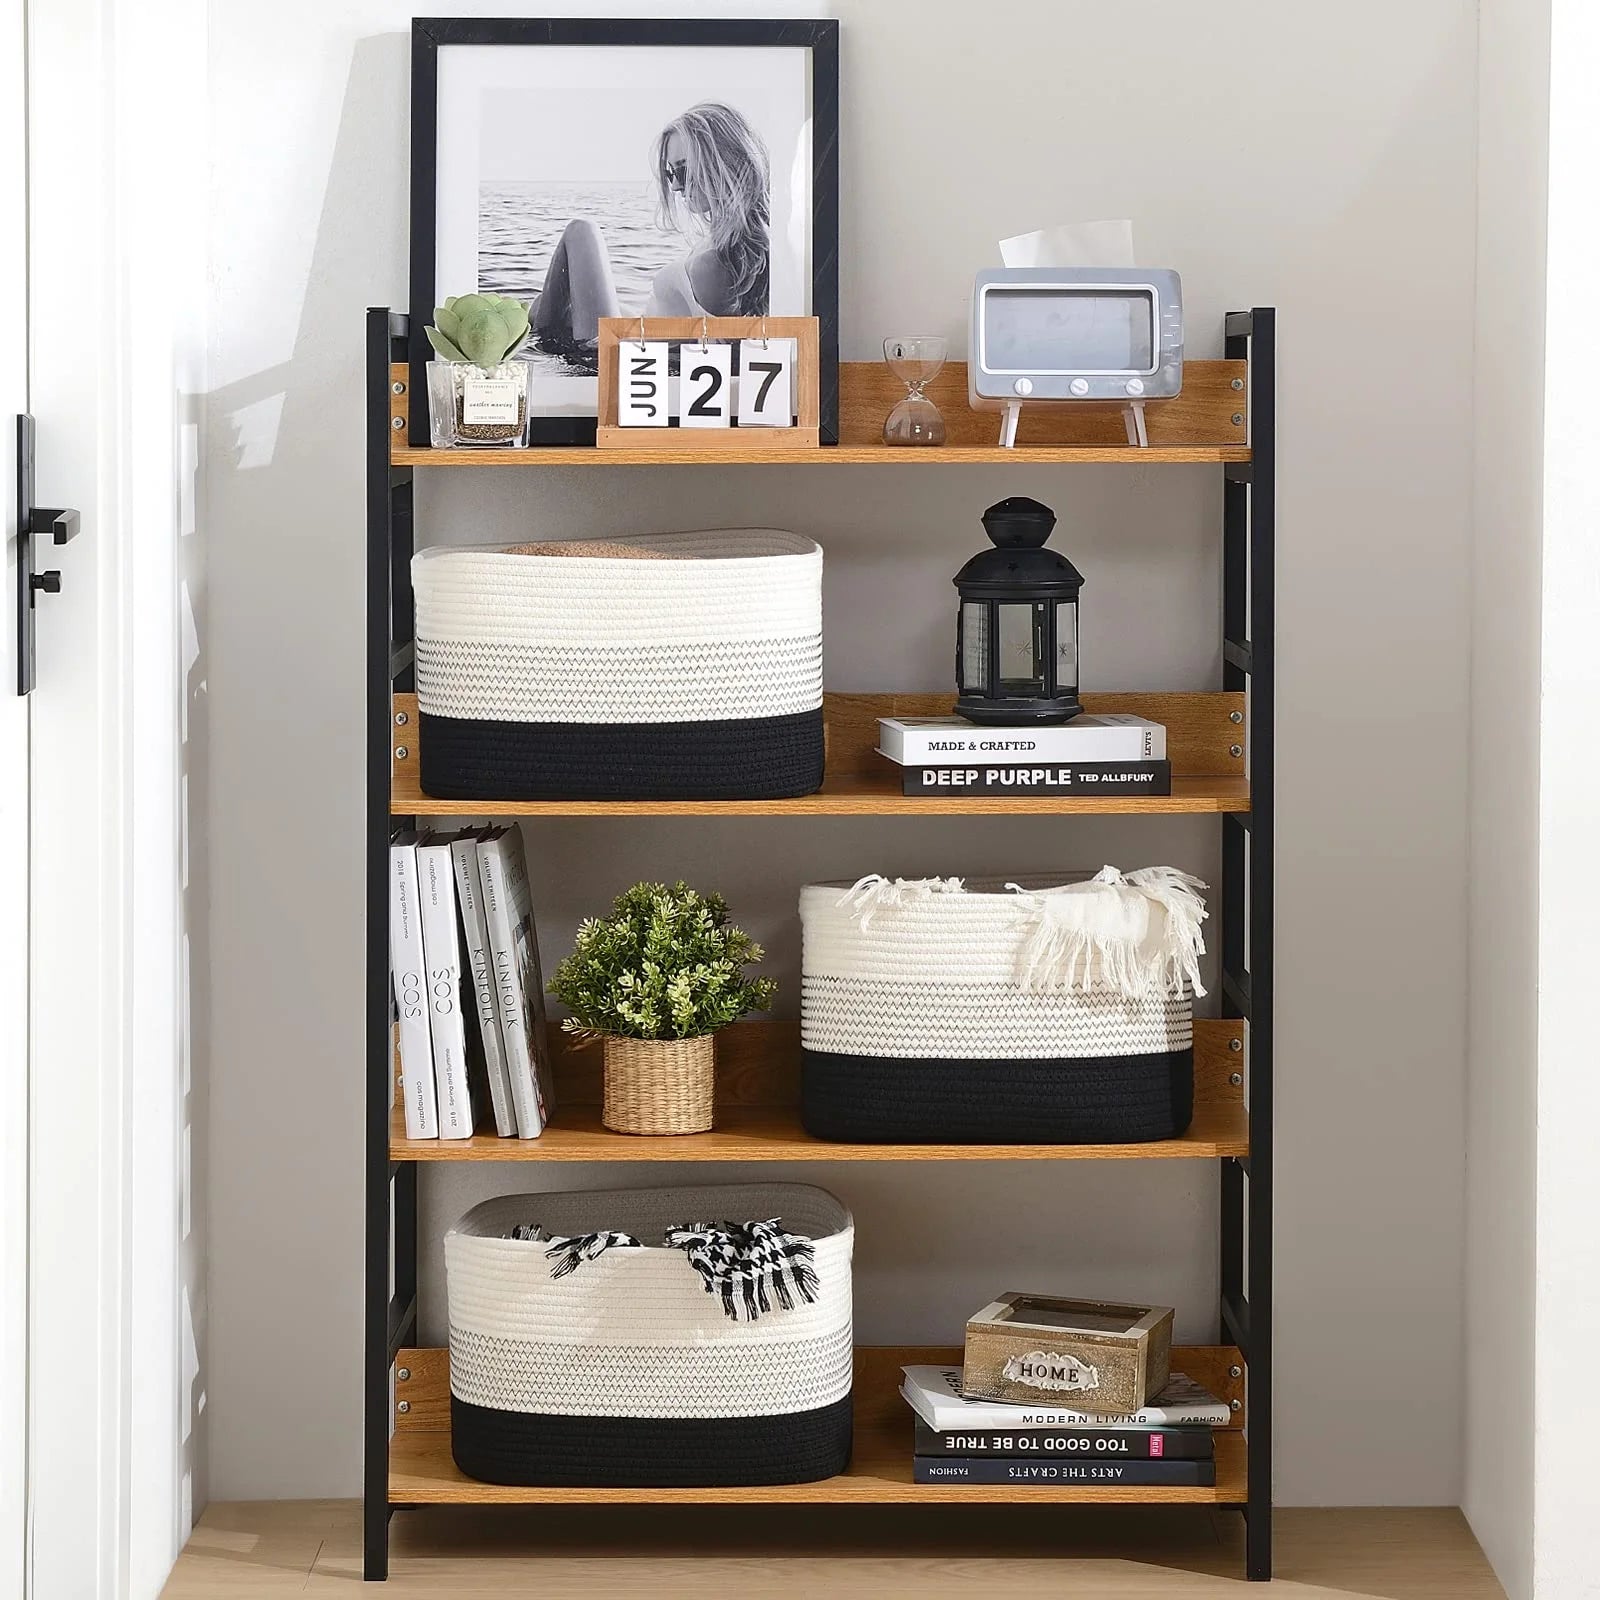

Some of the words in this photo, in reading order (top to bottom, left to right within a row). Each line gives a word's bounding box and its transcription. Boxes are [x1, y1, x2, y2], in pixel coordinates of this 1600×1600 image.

[630, 358, 657, 418] JUN
[687, 365, 722, 417] 2
[748, 361, 783, 413] 7
[928, 741, 965, 751] MADE
[968, 741, 977, 751] &
[979, 741, 1036, 751] CRAFTED
[1144, 731, 1152, 756] LEVI'S
[922, 769, 979, 786] DEEP
[985, 769, 1072, 785] PURPLE
[1078, 773, 1099, 782] TED
[1101, 773, 1155, 782] ALLBFURY
[461, 854, 470, 881] VOLUME
[484, 856, 493, 884] VOLUME
[433, 968, 453, 1015] COS
[473, 948, 495, 1027] KINFOLK
[497, 950, 519, 1029] KINFOLK
[402, 971, 422, 1018] COS
[1020, 1363, 1080, 1383] HOME
[1022, 1415, 1088, 1424] MODERN
[1096, 1415, 1147, 1423] LIVING
[945, 1436, 987, 1449] TRUE
[992, 1437, 1013, 1449] BE
[1018, 1437, 1039, 1450] TO
[1043, 1438, 1091, 1451] GOOD
[1095, 1438, 1129, 1452] TOO
[929, 1467, 969, 1475] FASHION
[1008, 1467, 1058, 1477] CRAFTS
[1062, 1467, 1087, 1478] THE
[1091, 1467, 1123, 1478] ARTS
